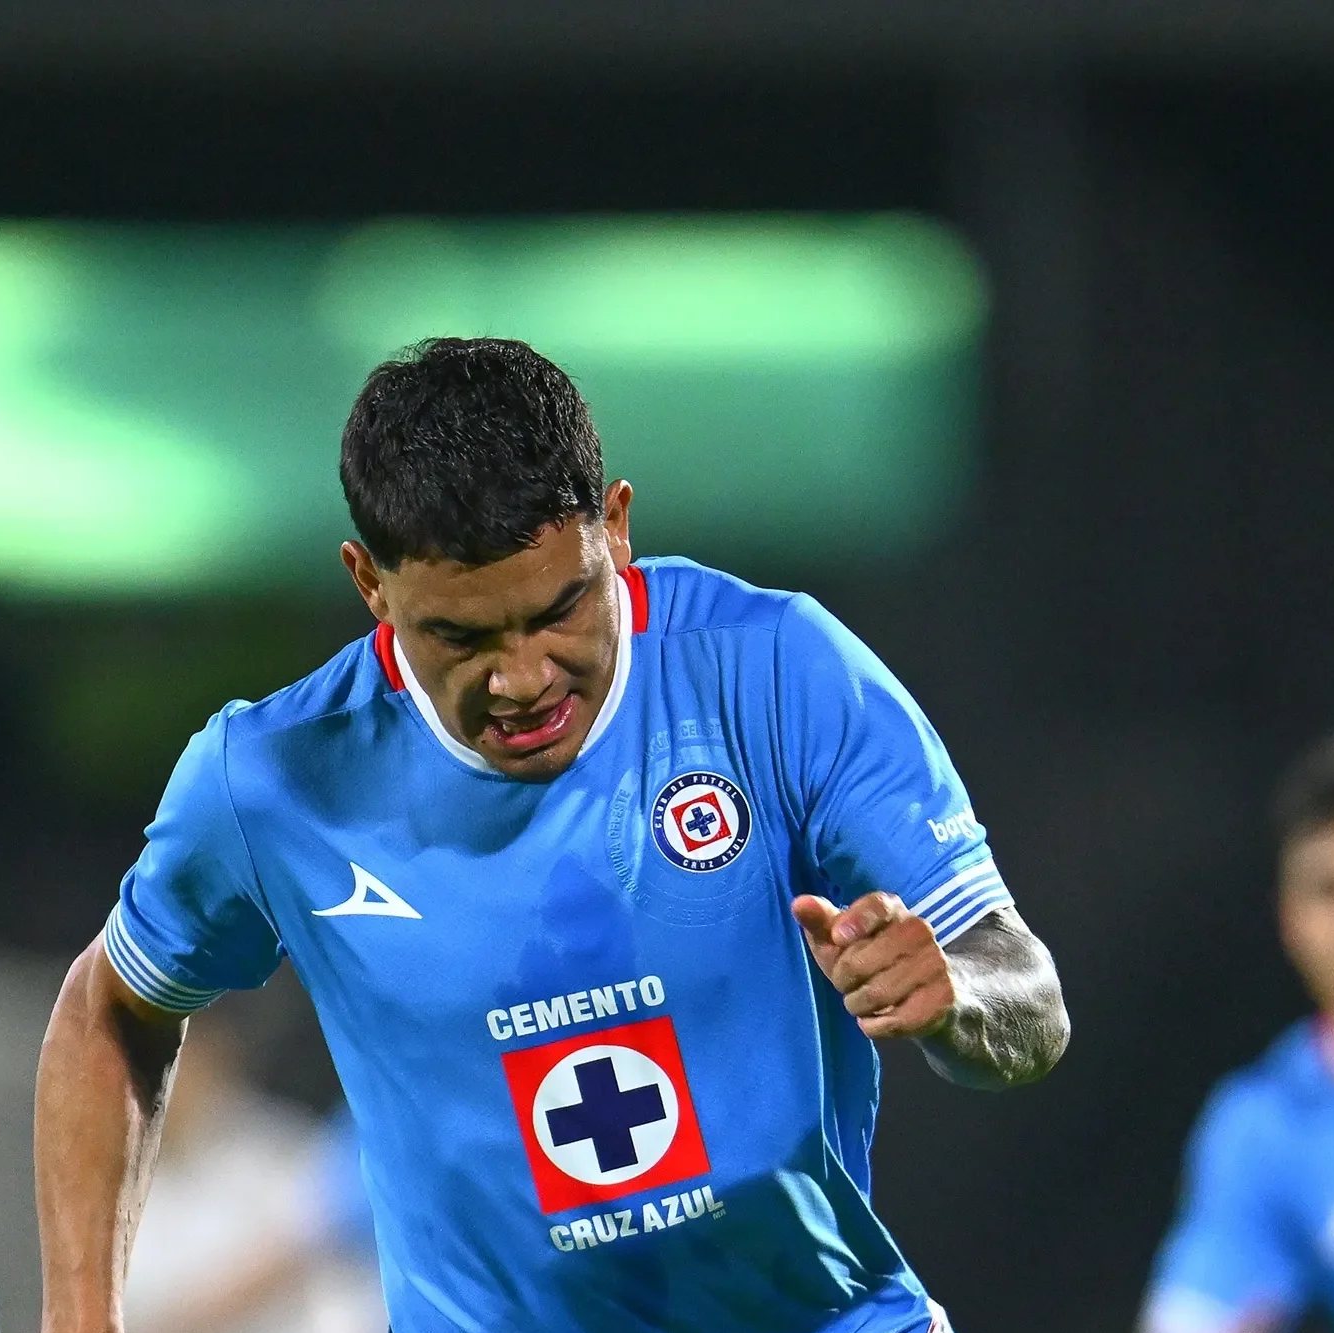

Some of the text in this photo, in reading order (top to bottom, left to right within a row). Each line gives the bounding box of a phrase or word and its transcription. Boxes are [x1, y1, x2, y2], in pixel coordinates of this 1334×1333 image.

[655, 775, 738, 829] CLUB DE FUTBOL
[682, 837, 745, 869] CRUZ AZUL
[486, 975, 665, 1041] CEMENTO
[549, 1185, 724, 1252] CRUZ AZUL
